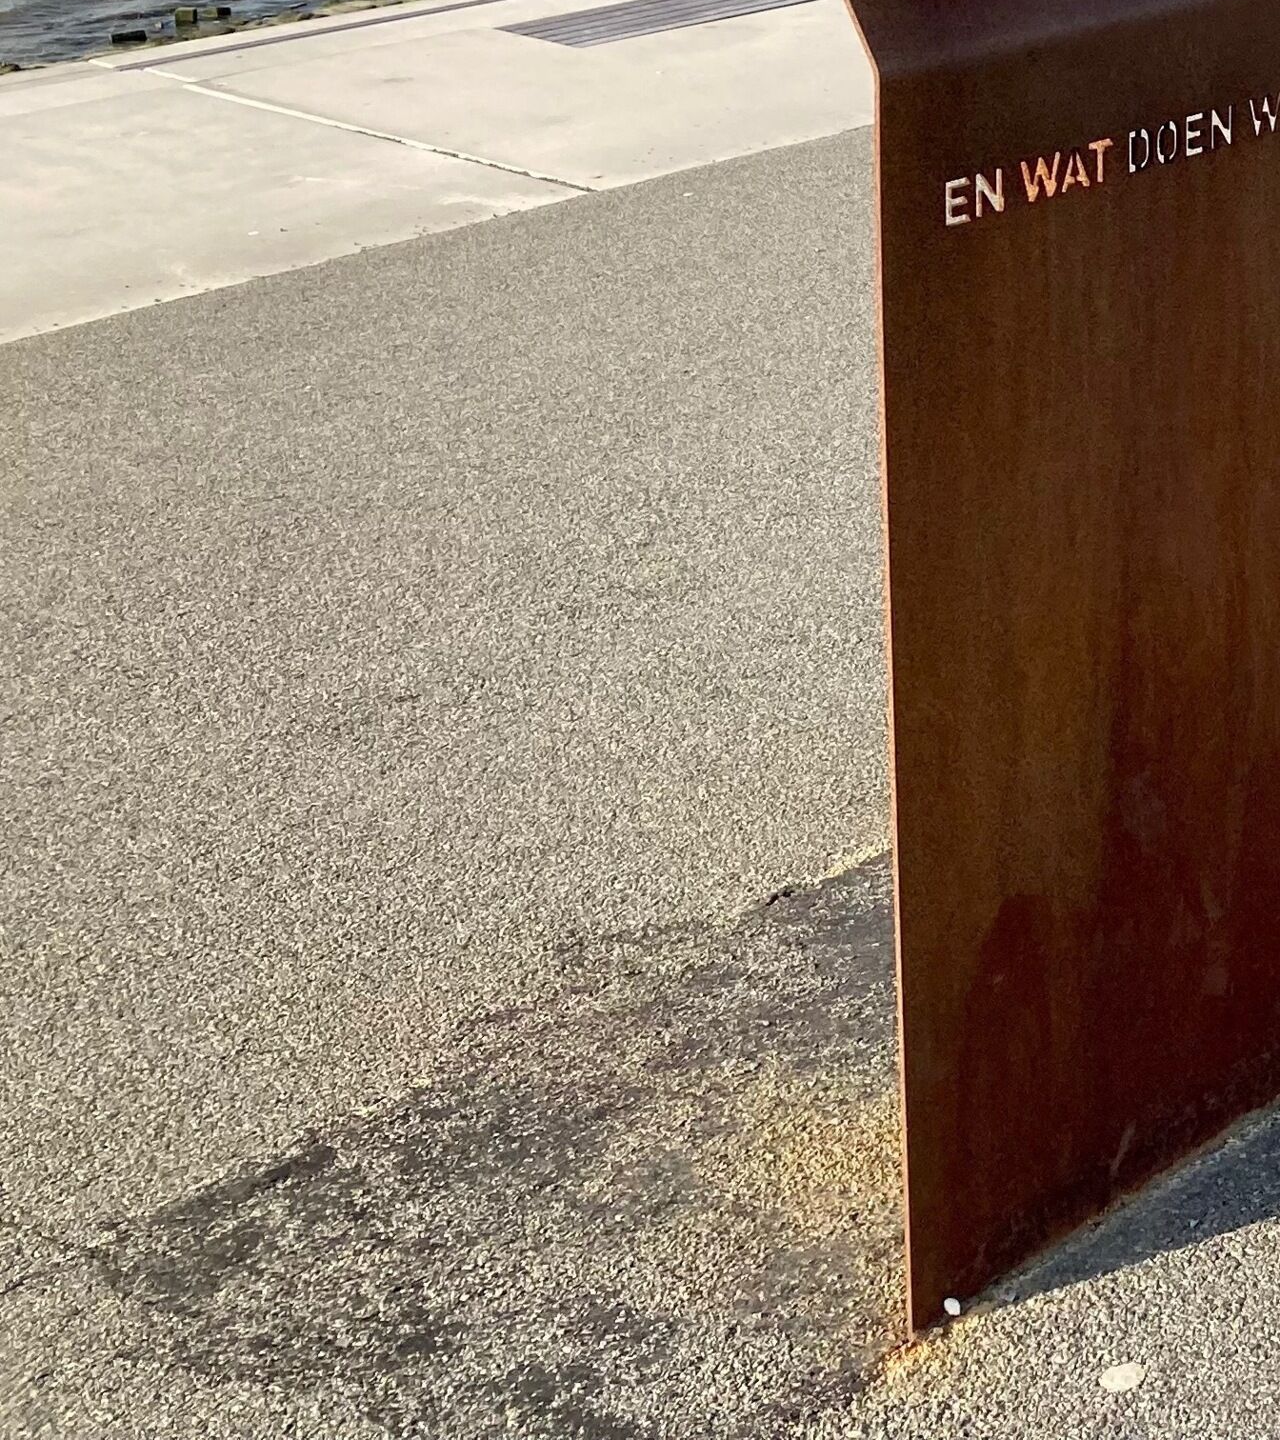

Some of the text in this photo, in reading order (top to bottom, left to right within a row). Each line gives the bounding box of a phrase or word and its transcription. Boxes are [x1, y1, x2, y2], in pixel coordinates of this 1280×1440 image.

[945, 169, 1004, 227] EN
[1020, 138, 1114, 204] WAT
[1127, 104, 1233, 174] DOEN
